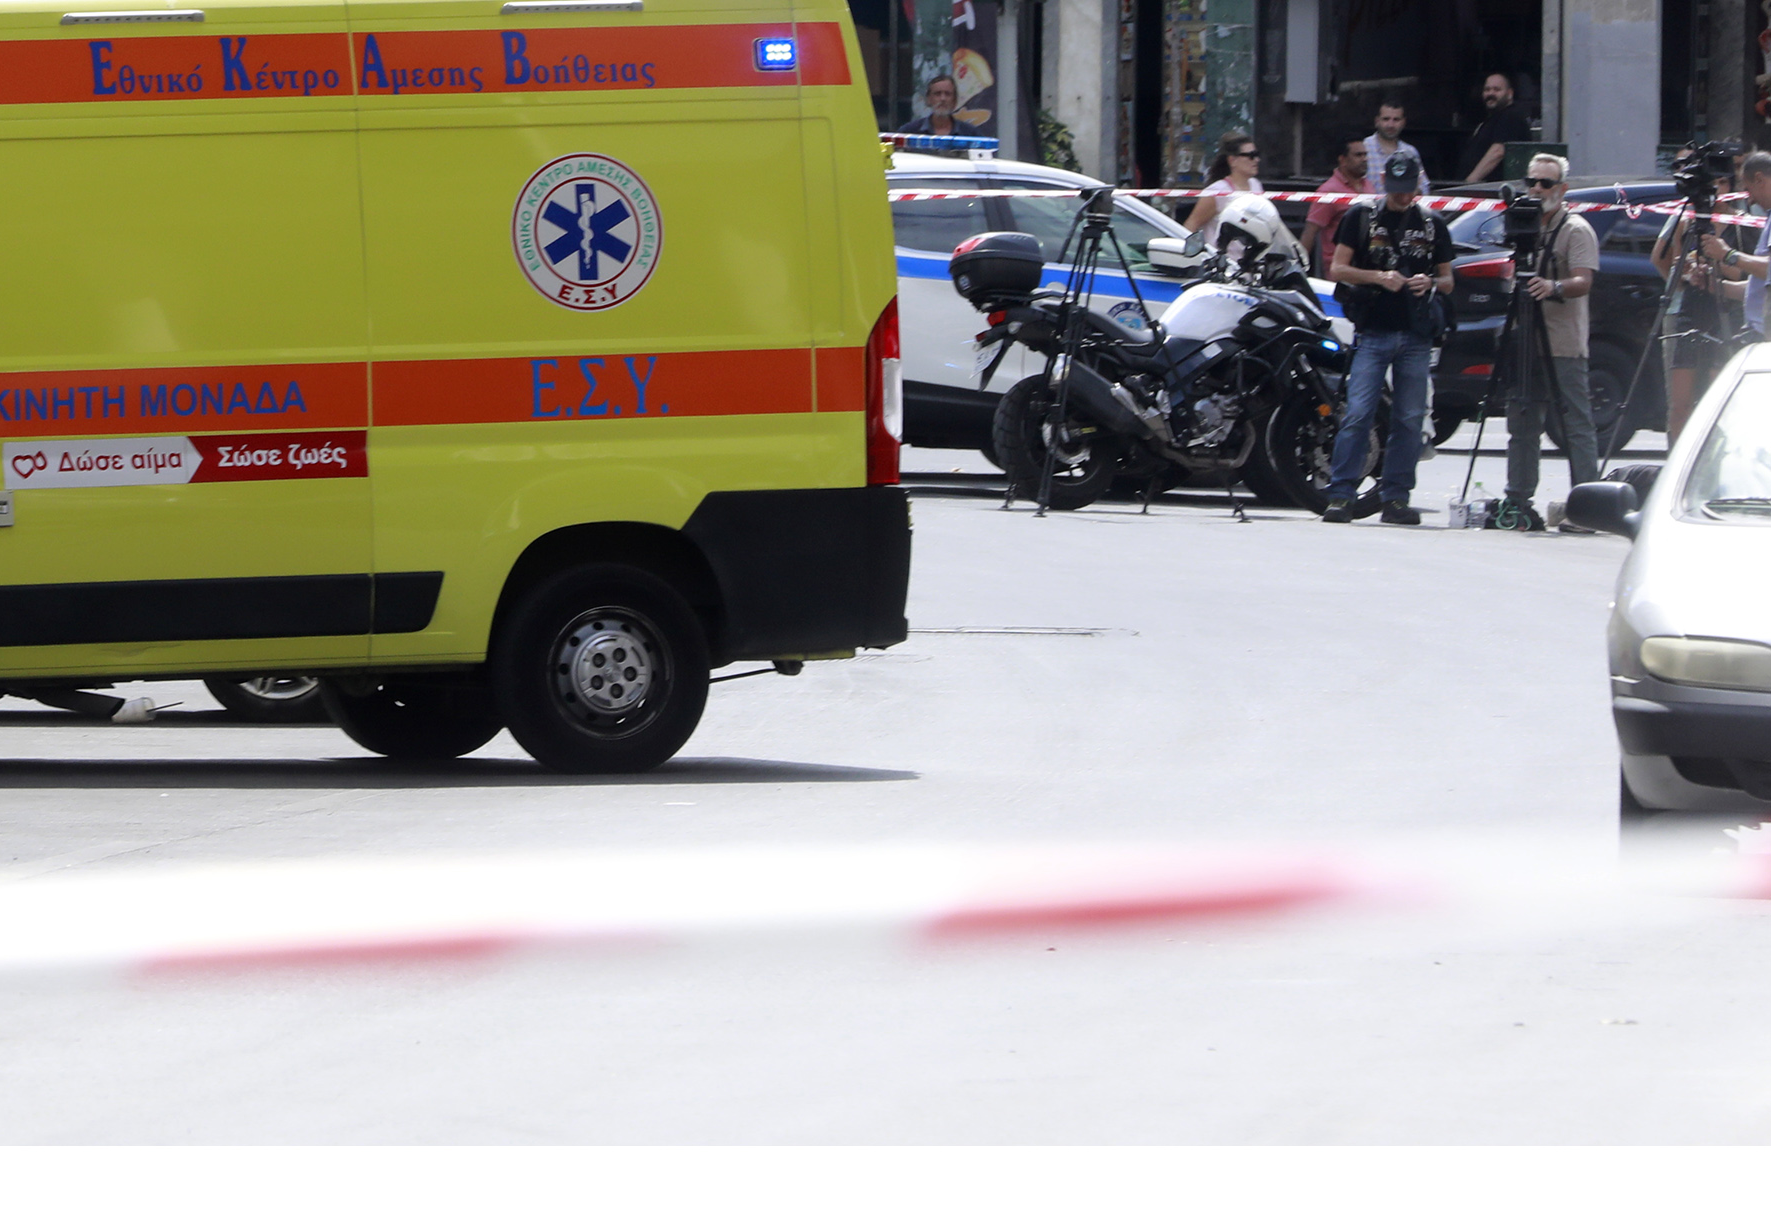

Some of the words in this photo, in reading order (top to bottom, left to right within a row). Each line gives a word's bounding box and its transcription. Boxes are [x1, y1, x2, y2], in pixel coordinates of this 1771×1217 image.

[89, 40, 204, 96] Εθνικό
[220, 36, 340, 97] Κέντρο
[499, 30, 656, 87] Βοήθειας
[526, 163, 574, 207] ΚΕΝΤΡΟ
[577, 161, 634, 191] ΑΜΕΣΗΣ
[630, 187, 656, 270] ΒΟΗΘΕΙΑΣ
[139, 380, 307, 419] ΜΟΝΑΔΑ
[530, 356, 670, 419] Ε.Σ.Υ.
[58, 447, 125, 473] Δώσε
[131, 445, 183, 474] αίμα
[217, 444, 283, 469] Σώσε
[288, 439, 347, 469] ζωές
